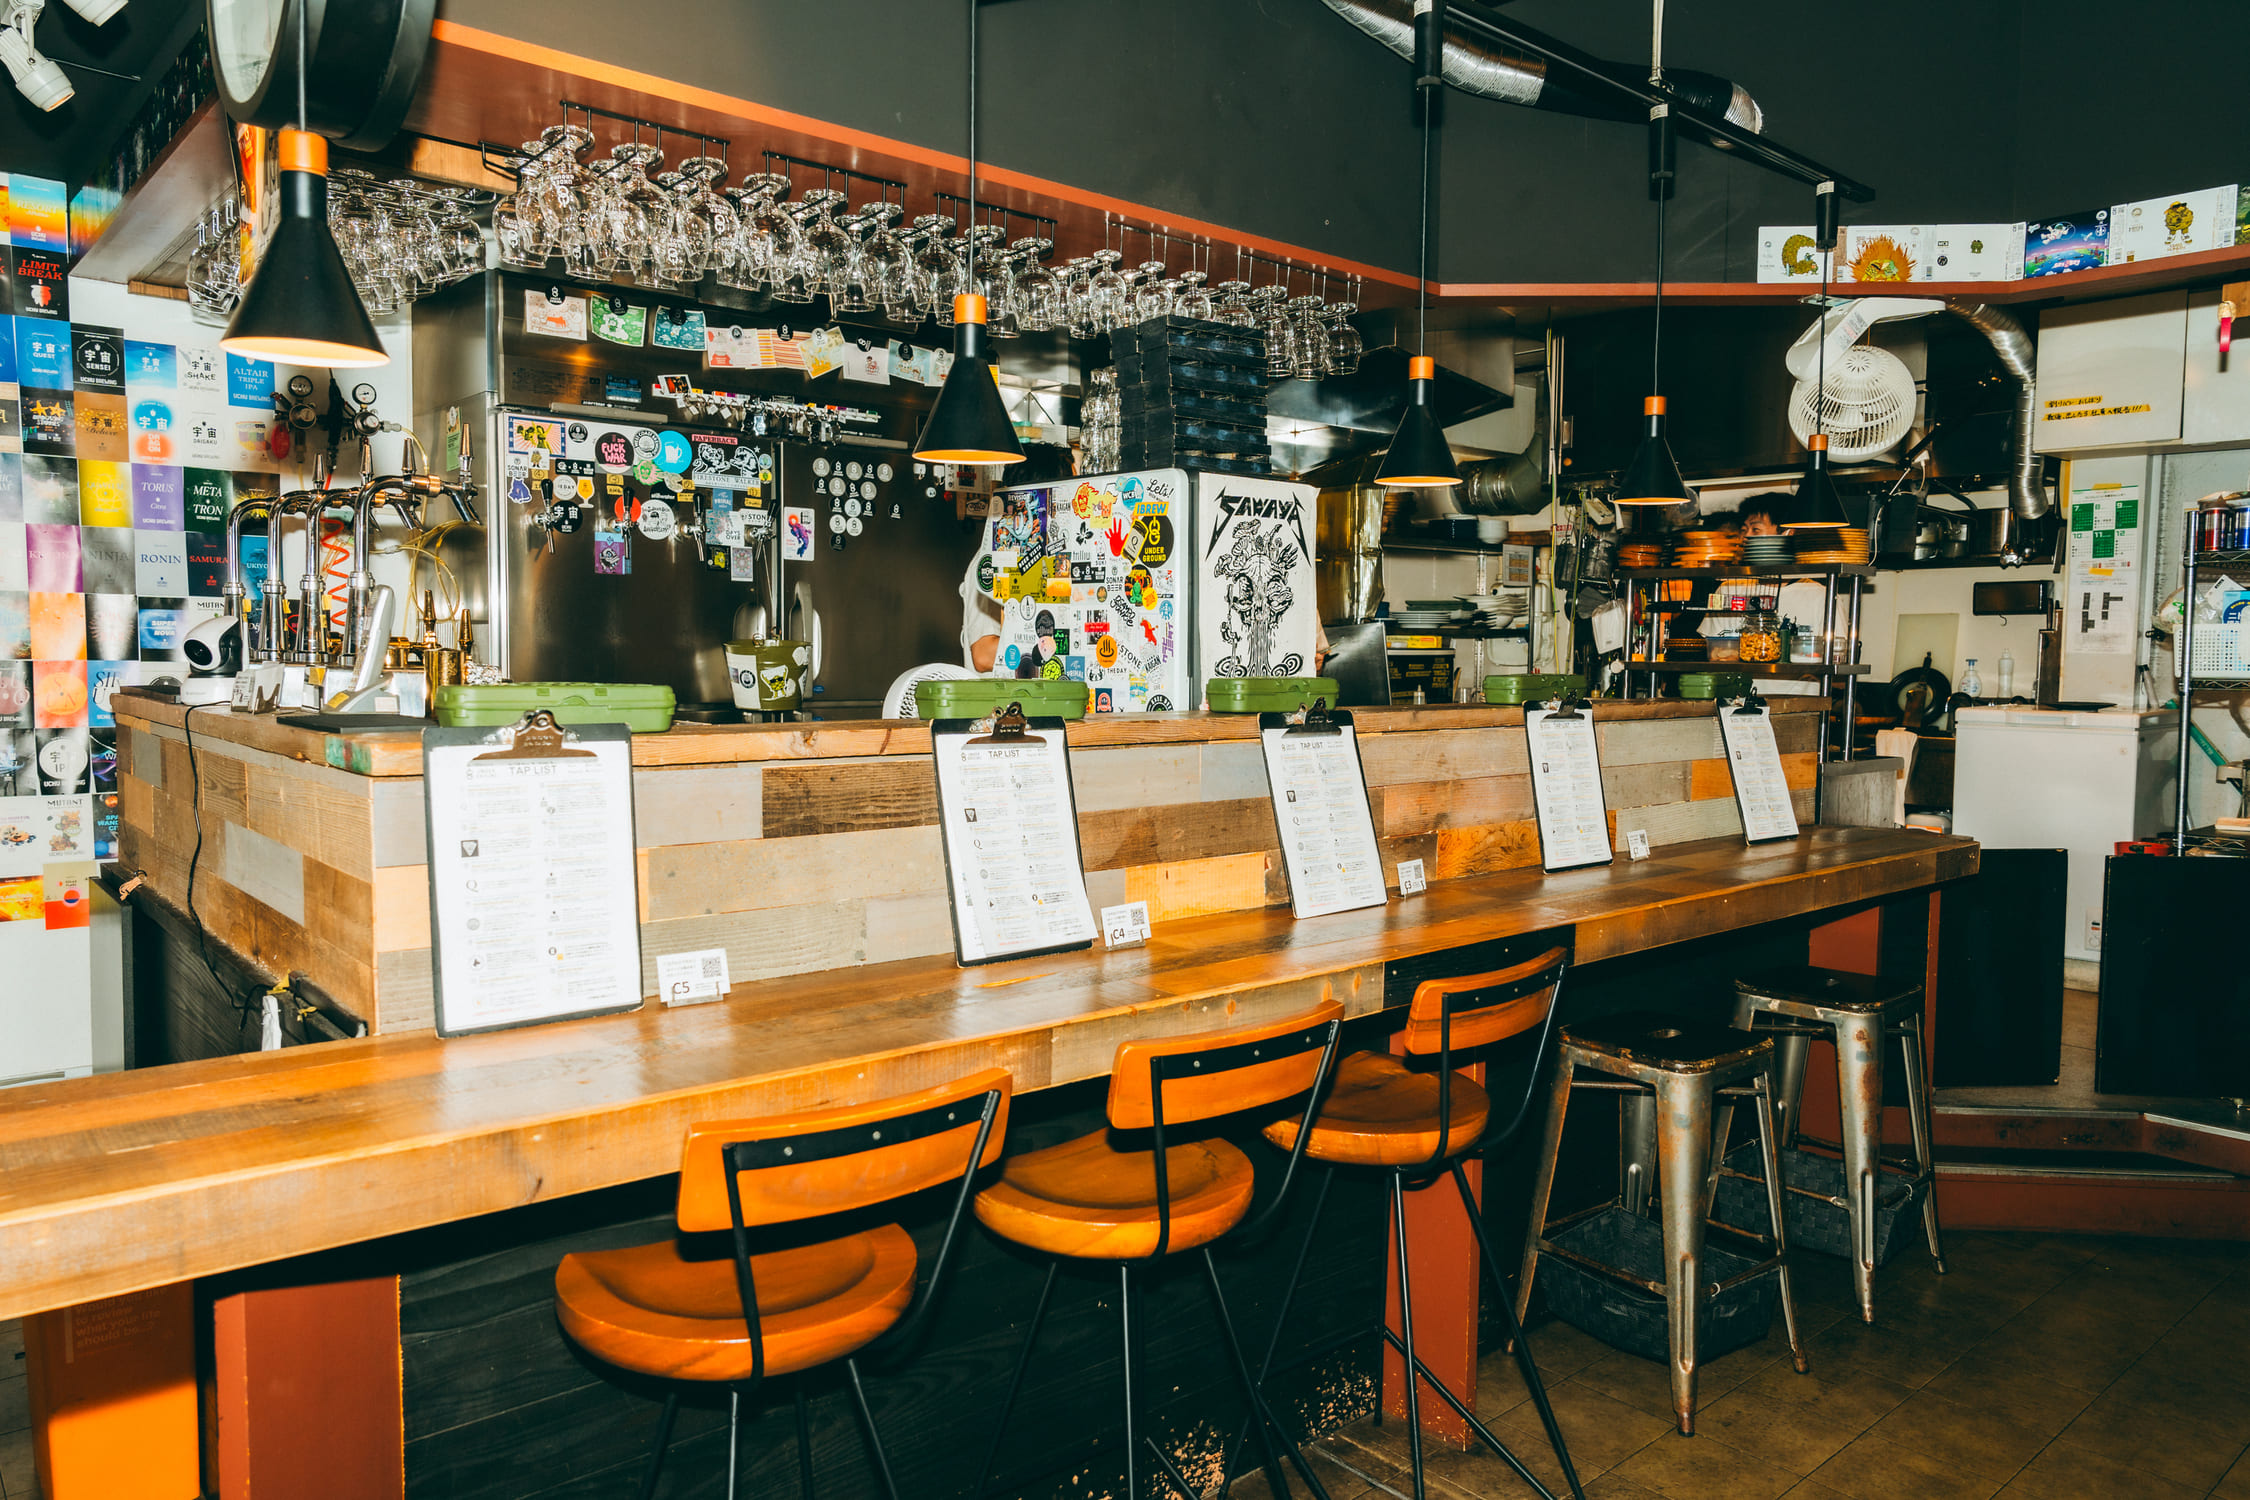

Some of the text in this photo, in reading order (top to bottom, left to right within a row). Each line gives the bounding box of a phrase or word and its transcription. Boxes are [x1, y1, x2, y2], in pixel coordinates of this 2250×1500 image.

[22, 259, 60, 271] LIMIT
[18, 266, 63, 281] BREAK
[85, 349, 112, 363] 宇宙
[86, 362, 111, 371] SENSEI
[192, 360, 213, 372] 宇宙
[187, 371, 216, 381] SHAKE
[233, 367, 269, 378] ALTAIR
[238, 375, 265, 385] TRIPLE
[139, 416, 168, 431] 宇宙
[192, 426, 217, 439] 宇宙
[693, 435, 736, 444] PAPERBACK
[601, 443, 626, 454] FUCK
[604, 453, 627, 464] WAR
[693, 474, 760, 486] FIRESTONE WALKER
[141, 482, 174, 493] TORUS
[193, 486, 222, 497] META
[1146, 478, 1174, 498] Let's!
[193, 503, 223, 516] TRON
[554, 505, 578, 519] 宇宙
[140, 553, 182, 564] RONIN
[189, 555, 228, 564] SAMURA
[1106, 576, 1124, 584] SONAR
[197, 601, 224, 609] MUTAN
[1119, 645, 1142, 669] STONE
[1145, 657, 1162, 673] KAIGAN
[1300, 741, 1323, 750] TAP LIST
[1004, 749, 1020, 758] LIST
[509, 765, 558, 776] TAP LIST
[1404, 880, 1412, 890] C3
[1112, 928, 1125, 940] C4
[672, 981, 690, 994] C5
[91, 1306, 134, 1322] review
[108, 1315, 138, 1330] your
[77, 1331, 121, 1348] should
